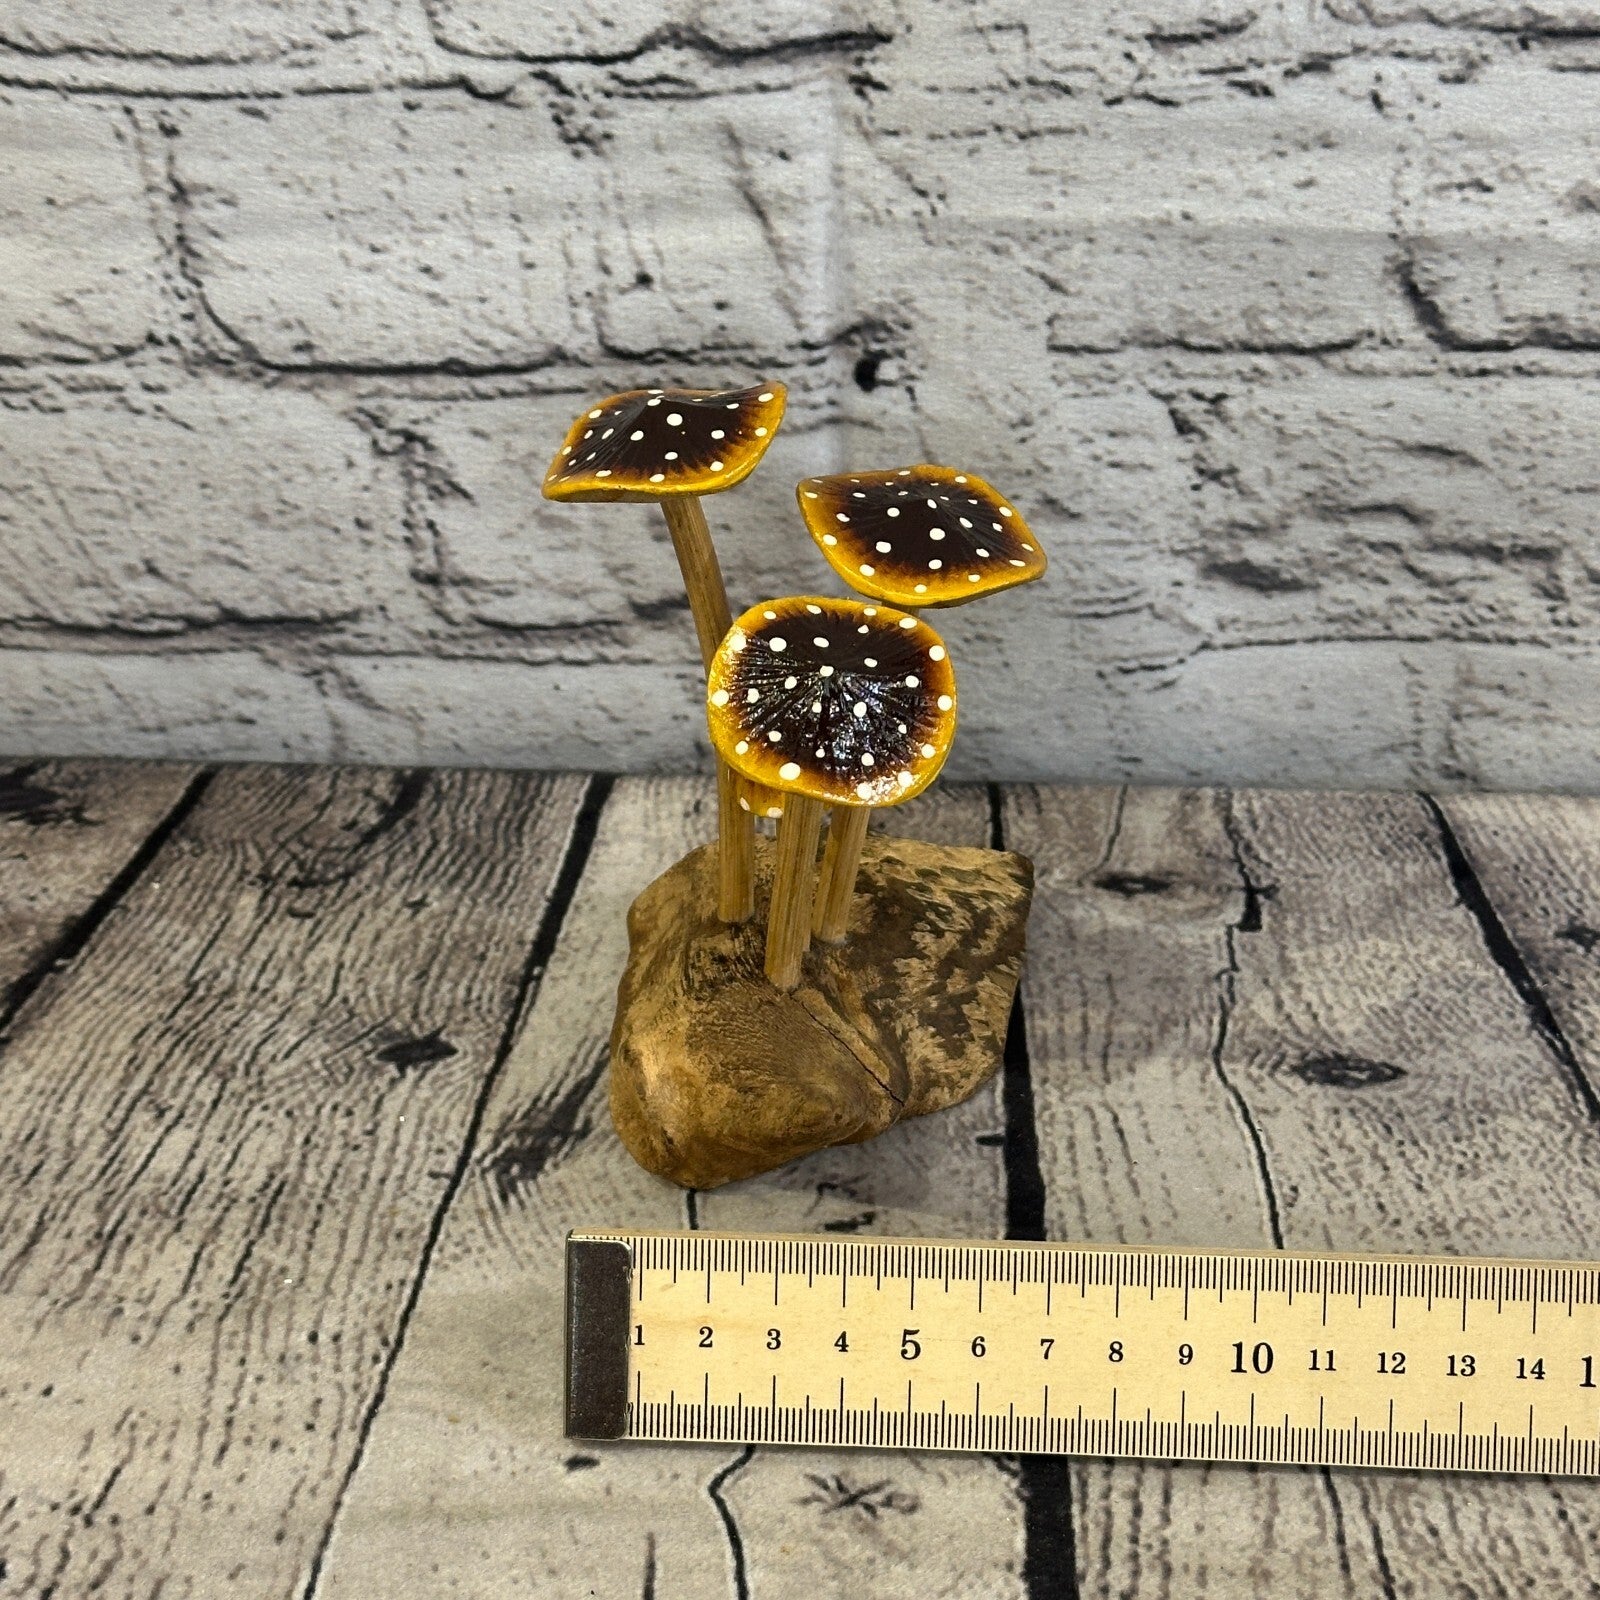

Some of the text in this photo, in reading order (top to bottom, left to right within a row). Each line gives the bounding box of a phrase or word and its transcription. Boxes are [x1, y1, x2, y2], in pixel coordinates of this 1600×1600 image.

[634, 1325, 1598, 1388] 1 2 3 4 5 6 7 8 9 10 11 12 13 14 1
